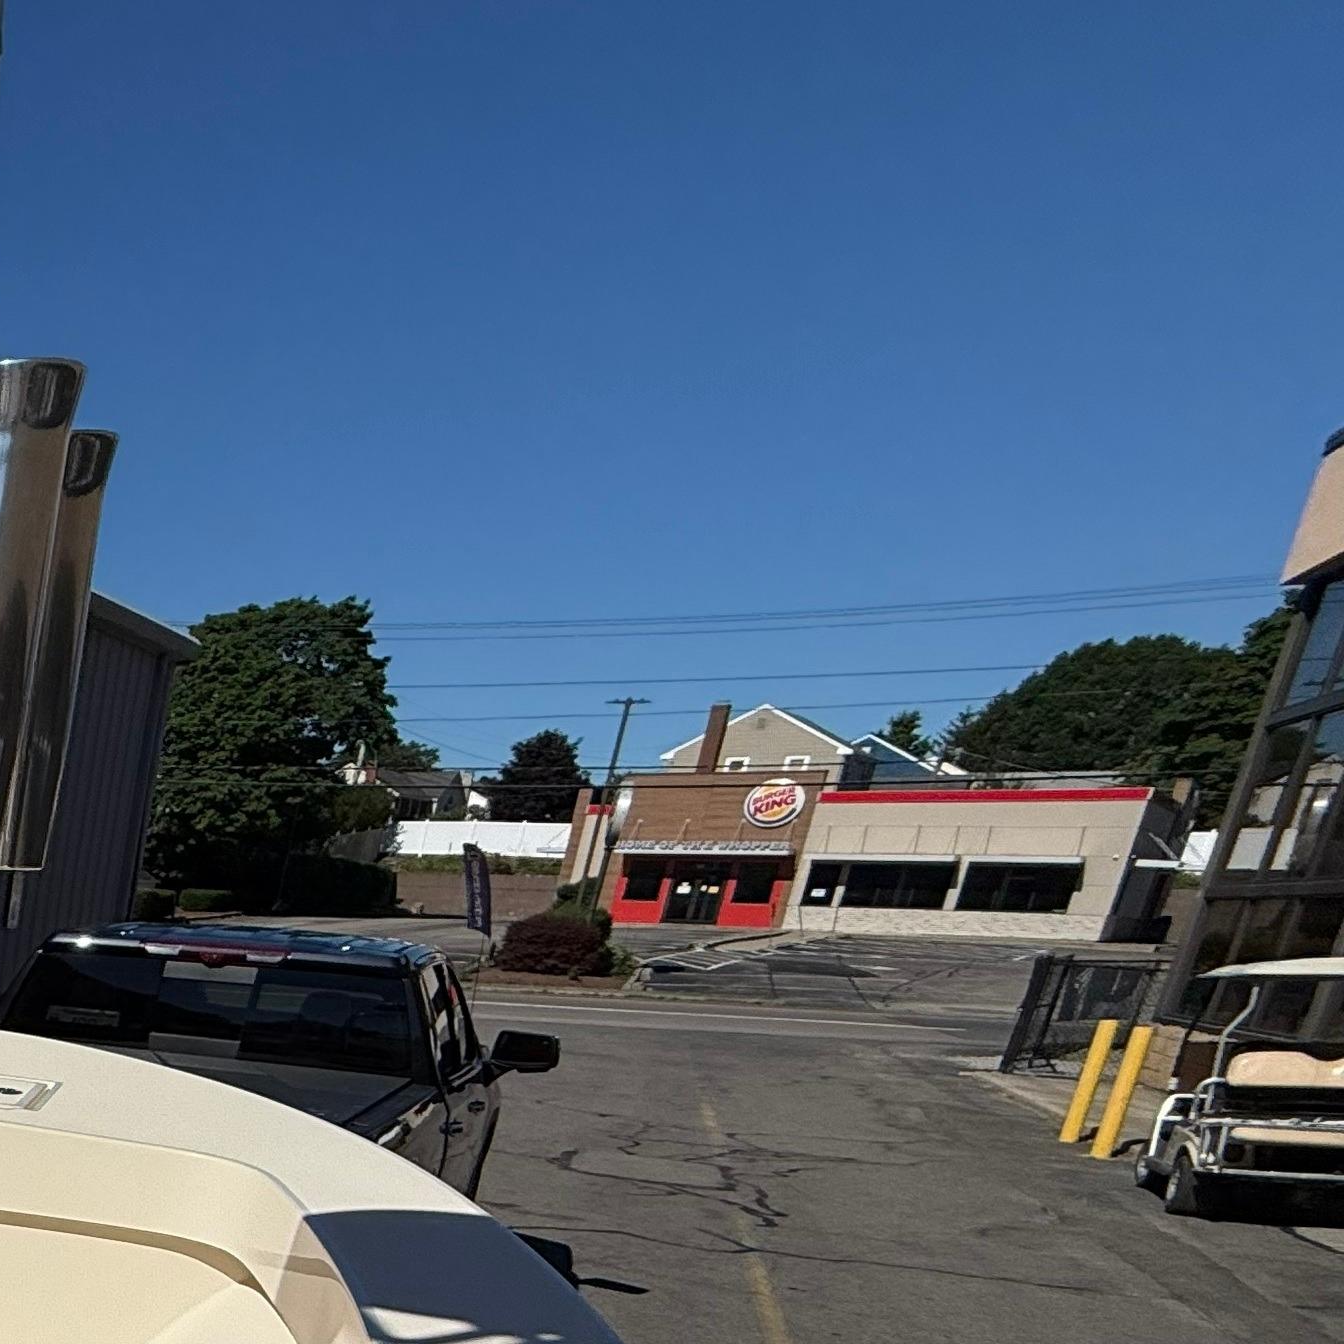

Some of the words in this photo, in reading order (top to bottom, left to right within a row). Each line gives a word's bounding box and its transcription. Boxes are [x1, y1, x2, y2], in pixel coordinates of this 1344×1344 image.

[752, 786, 797, 806] BURGER
[752, 794, 797, 817] KING
[616, 840, 656, 850] HOME
[658, 840, 678, 851] OF
[681, 840, 717, 851] THE
[718, 840, 791, 852] WHOPPER
